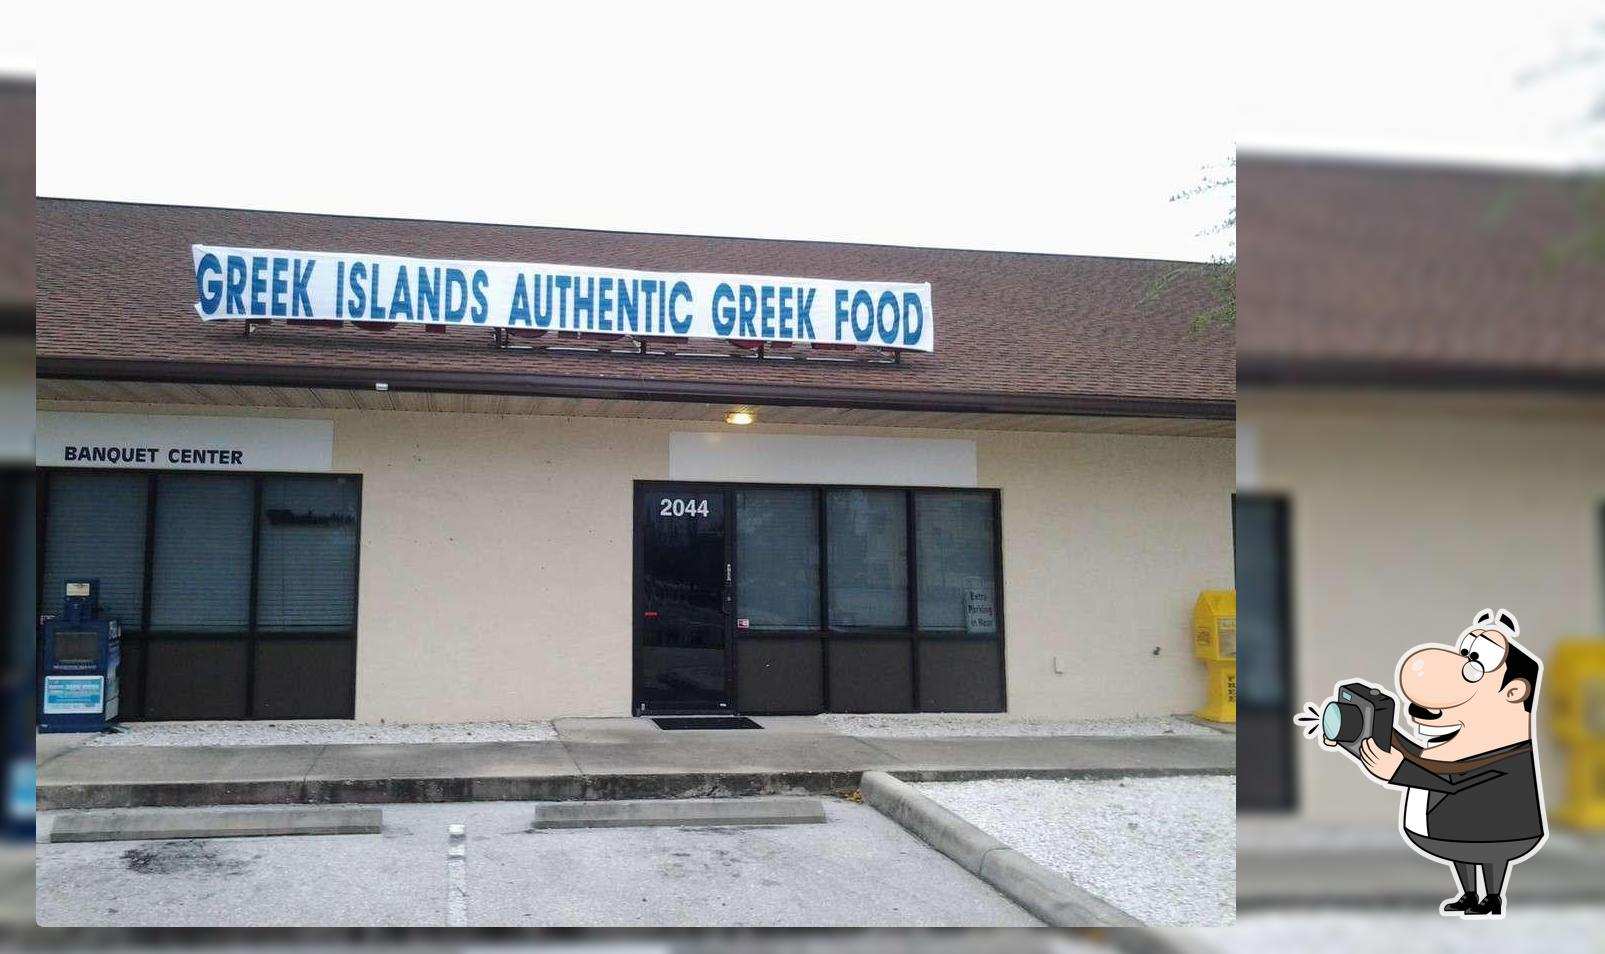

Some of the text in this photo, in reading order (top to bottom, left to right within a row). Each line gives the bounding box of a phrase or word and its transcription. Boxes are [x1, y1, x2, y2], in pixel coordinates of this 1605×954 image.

[197, 252, 317, 317] GREEK
[336, 260, 489, 324] ISLANDS
[508, 273, 694, 334] AUTHENTIC
[711, 282, 817, 340] GREEK
[835, 289, 924, 346] FOOD
[64, 446, 243, 465] BANQUET CENTER
[660, 498, 709, 517] 2044
